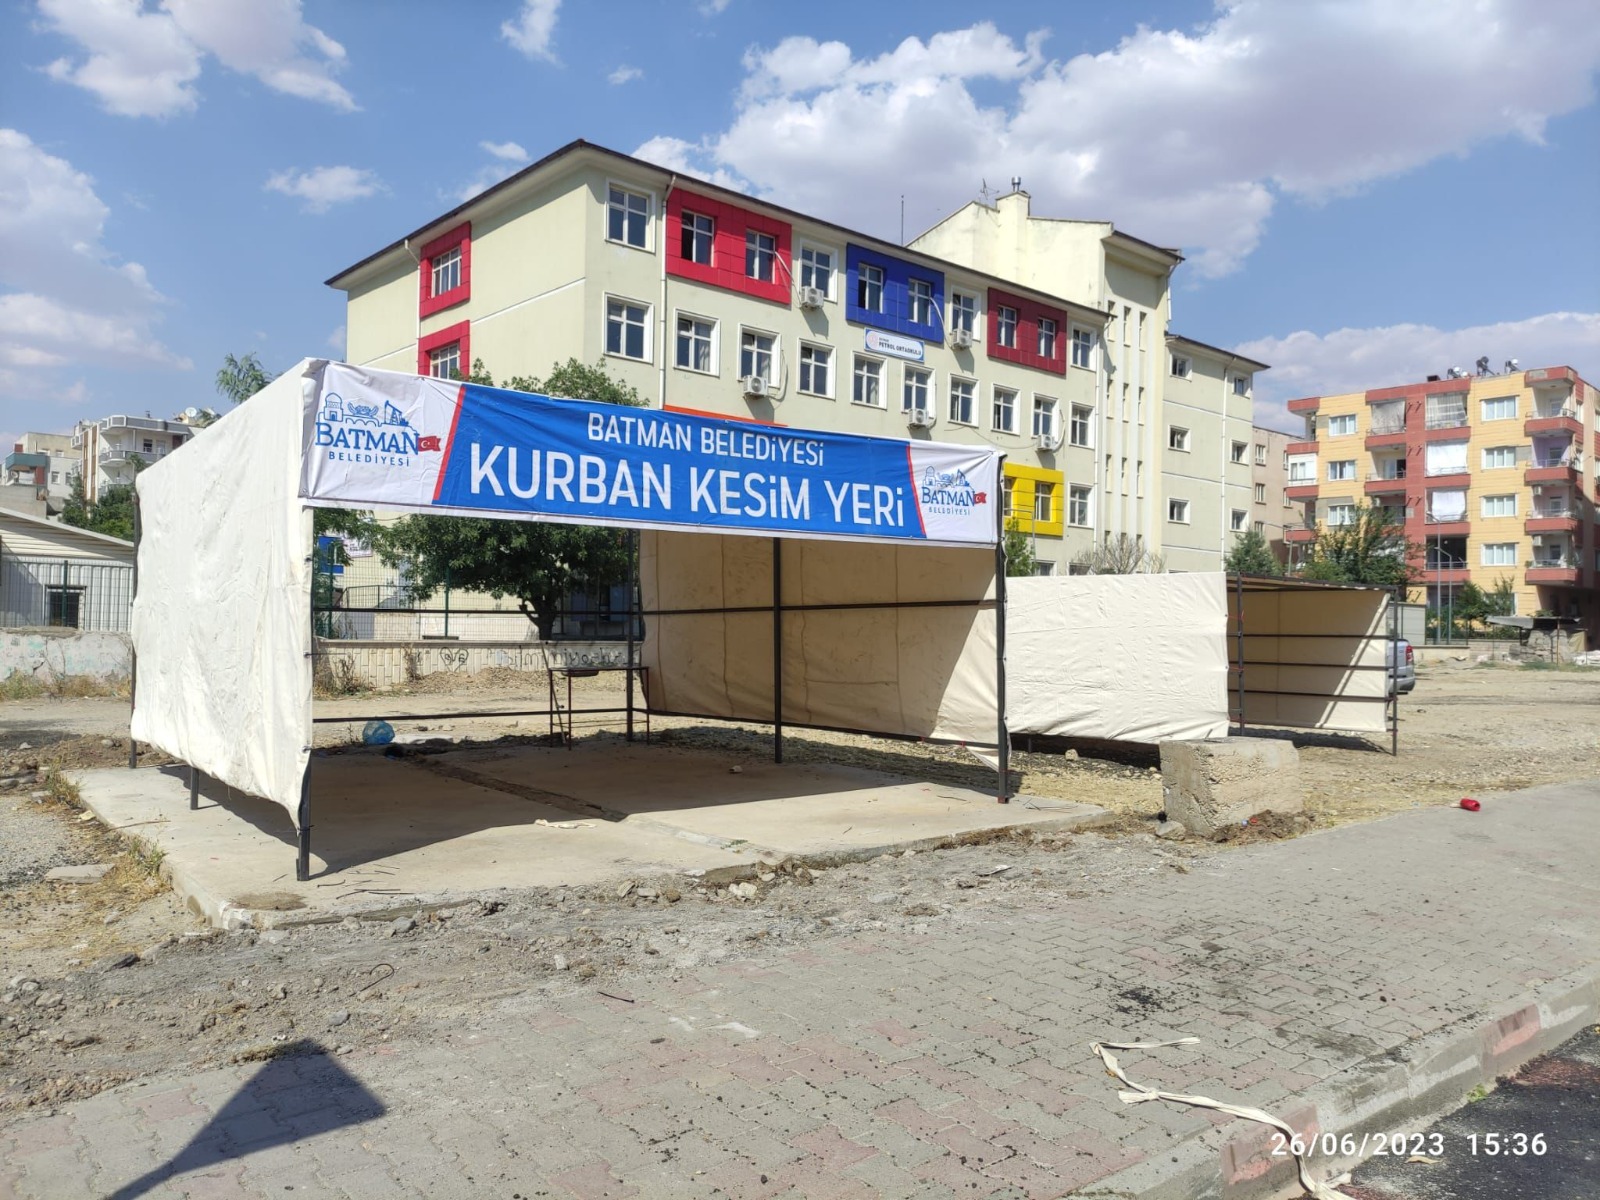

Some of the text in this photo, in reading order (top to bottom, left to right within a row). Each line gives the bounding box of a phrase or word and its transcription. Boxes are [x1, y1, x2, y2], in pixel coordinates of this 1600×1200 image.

[315, 421, 420, 456] BATMAN
[588, 412, 692, 452] BATMAN
[470, 442, 671, 510] KURBAN
[921, 486, 976, 507] BATMAN
